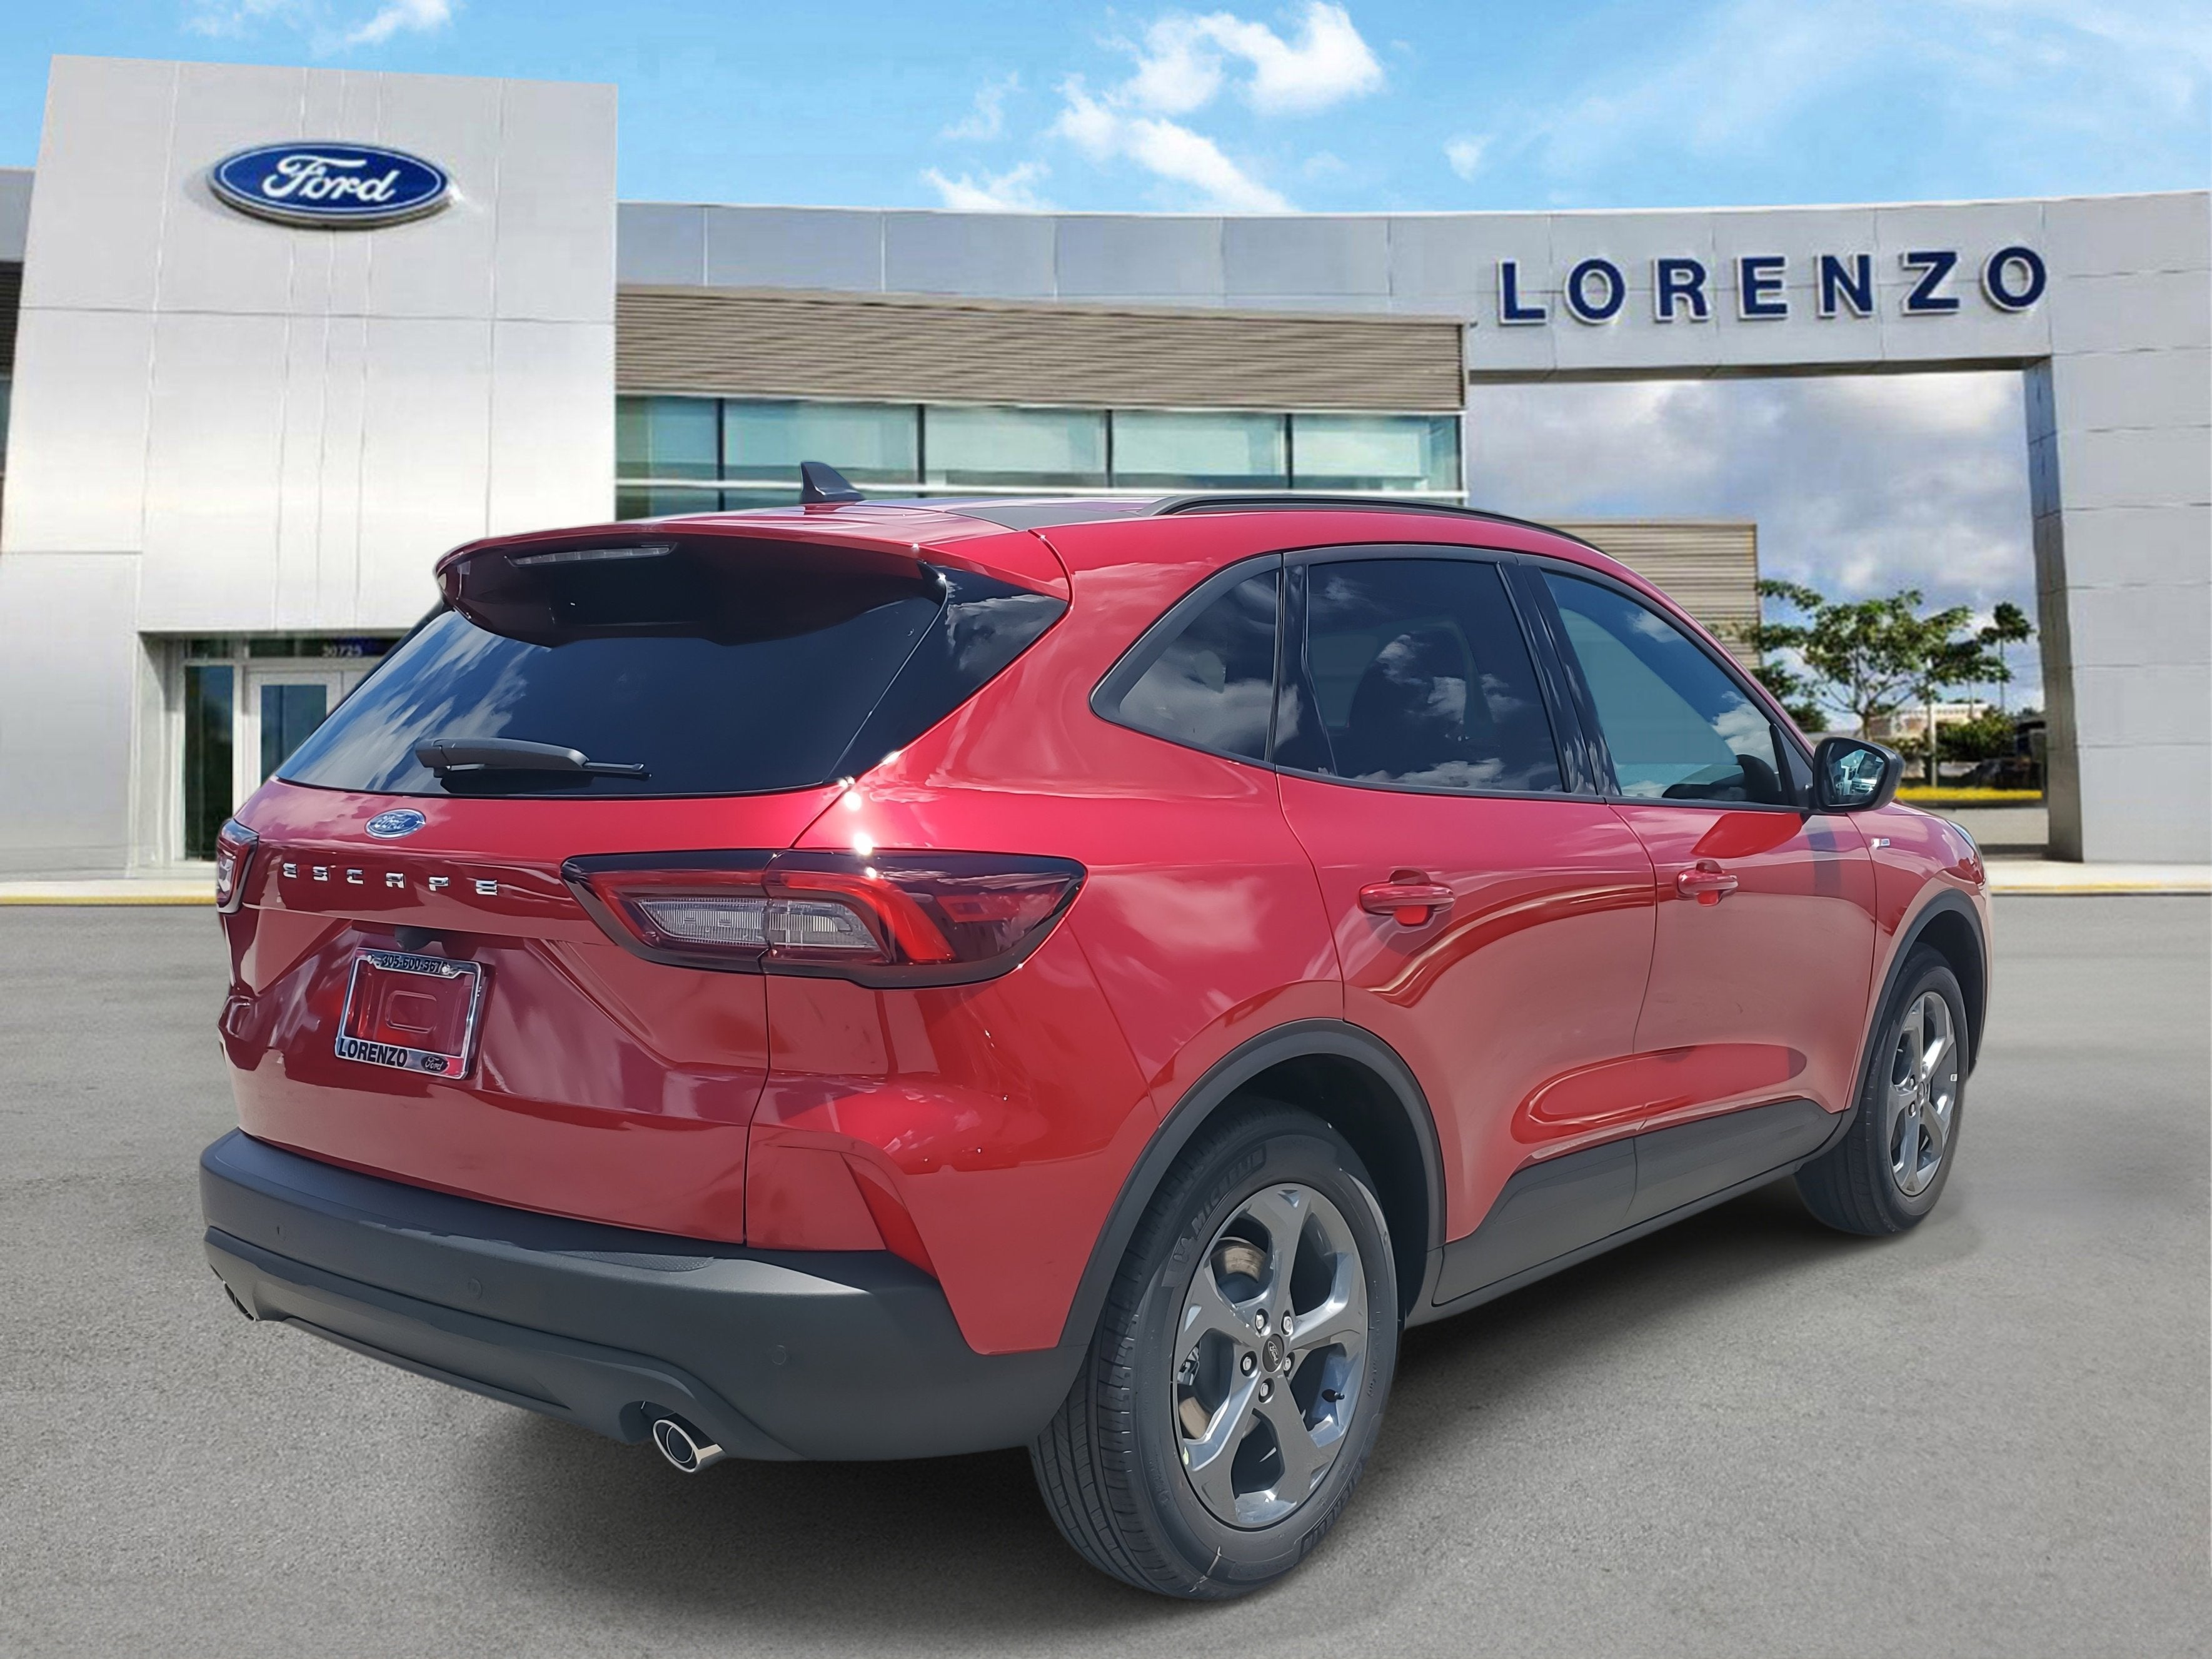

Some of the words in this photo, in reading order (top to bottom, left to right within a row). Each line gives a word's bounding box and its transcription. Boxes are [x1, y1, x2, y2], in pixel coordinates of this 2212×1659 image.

[262, 154, 401, 201] Ford
[1499, 246, 2048, 324] LORENZO
[283, 862, 498, 896] ESCAPE
[338, 1038, 408, 1067] LORENZO
[425, 1056, 444, 1071] Ford
